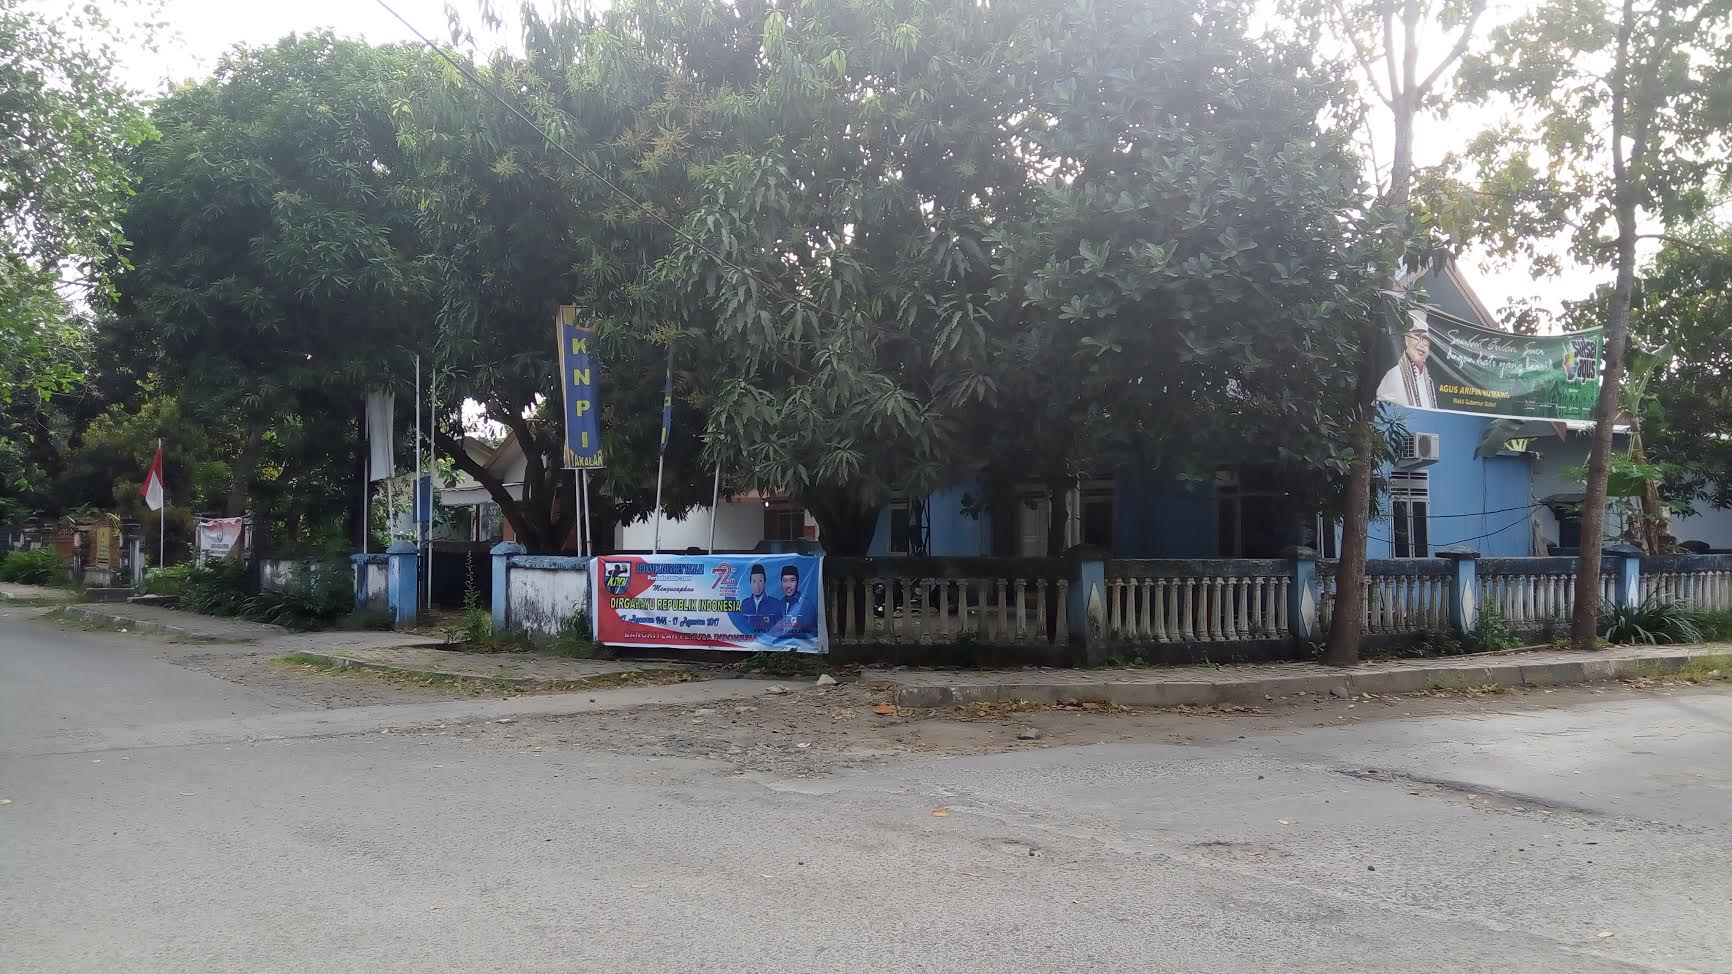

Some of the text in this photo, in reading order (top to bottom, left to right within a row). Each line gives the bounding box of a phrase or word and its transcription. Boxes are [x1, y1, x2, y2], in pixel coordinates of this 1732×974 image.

[1488, 337, 1518, 353] Bulan
[1498, 361, 1523, 378] yang
[572, 337, 591, 448] KNPI
[1439, 384, 1458, 394] AGUS
[1459, 386, 1482, 396] ARIFIN
[1465, 398, 1484, 407] Gubernur
[569, 449, 603, 467] TAKALAR
[652, 584, 695, 594] Mengucapkan
[610, 597, 742, 612] DIRGAHAYU REPUBLIK INDONESIA
[672, 616, 679, 624] 17
[680, 616, 706, 628] Agustus
[706, 617, 720, 627] 2017
